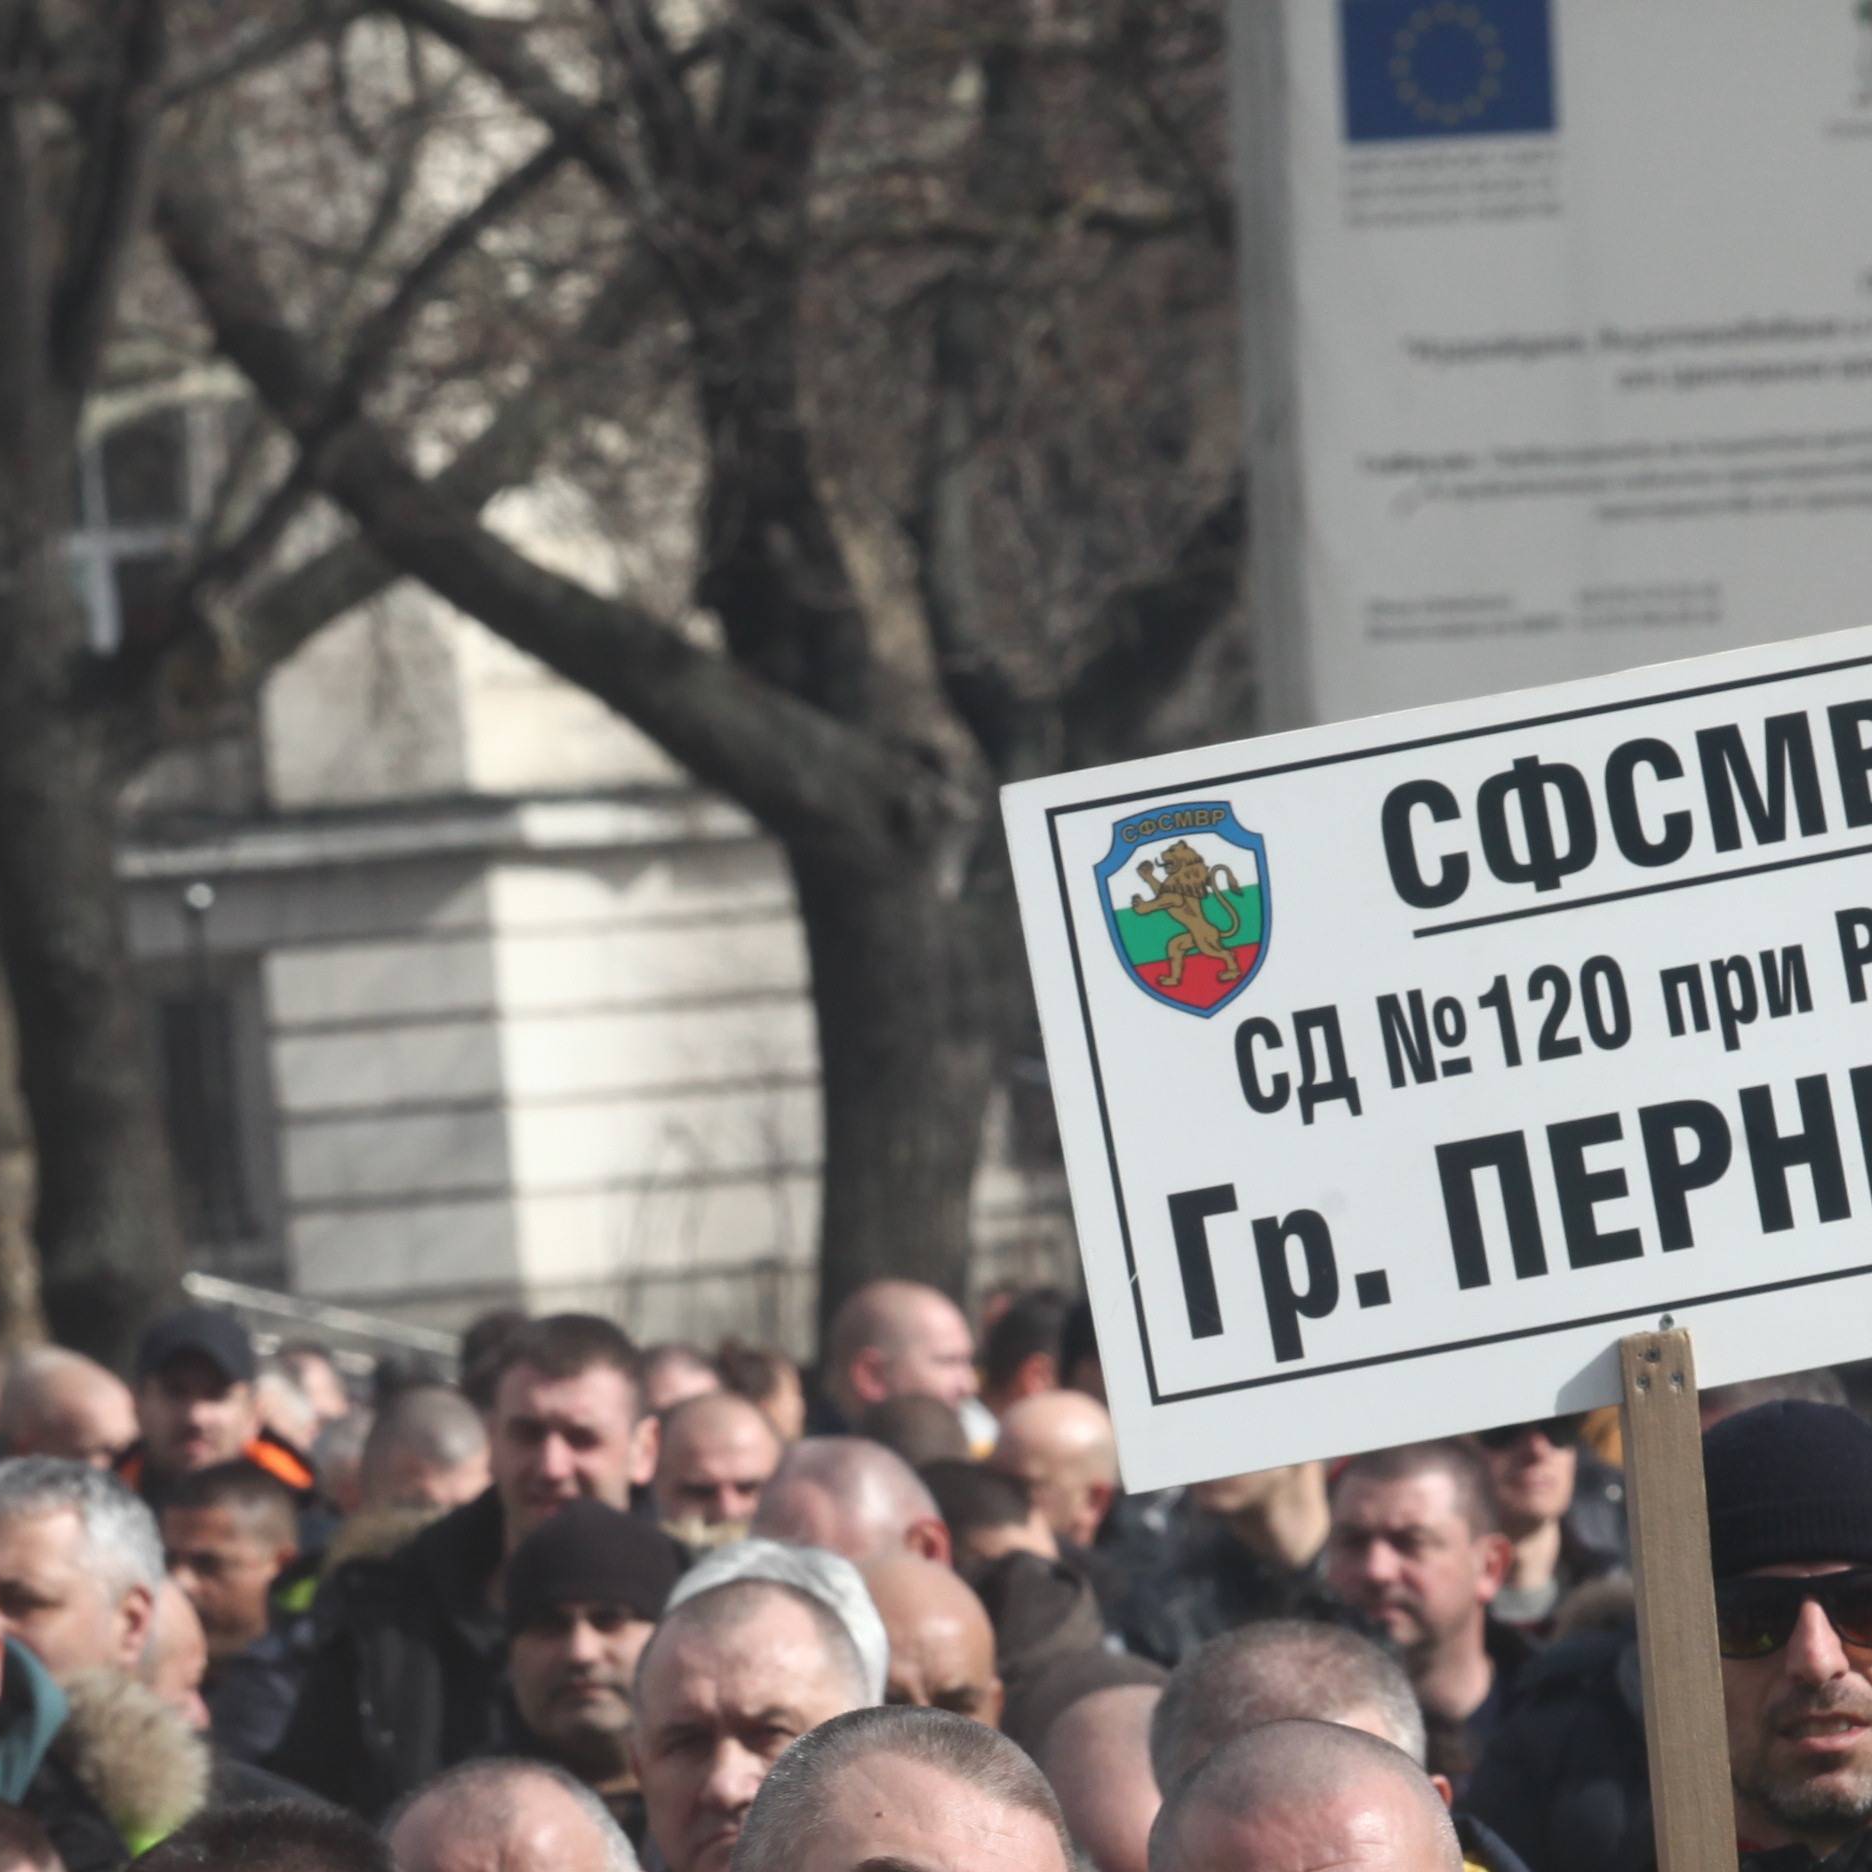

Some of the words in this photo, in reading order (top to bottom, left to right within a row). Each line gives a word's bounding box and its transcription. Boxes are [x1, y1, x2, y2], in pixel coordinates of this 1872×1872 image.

[1122, 809, 1226, 843] СФСМВР
[1235, 1005, 1361, 1125] СД
[1377, 956, 1631, 1088] №120
[1660, 945, 1812, 1051] при
[1168, 1184, 1390, 1362] Гр.
